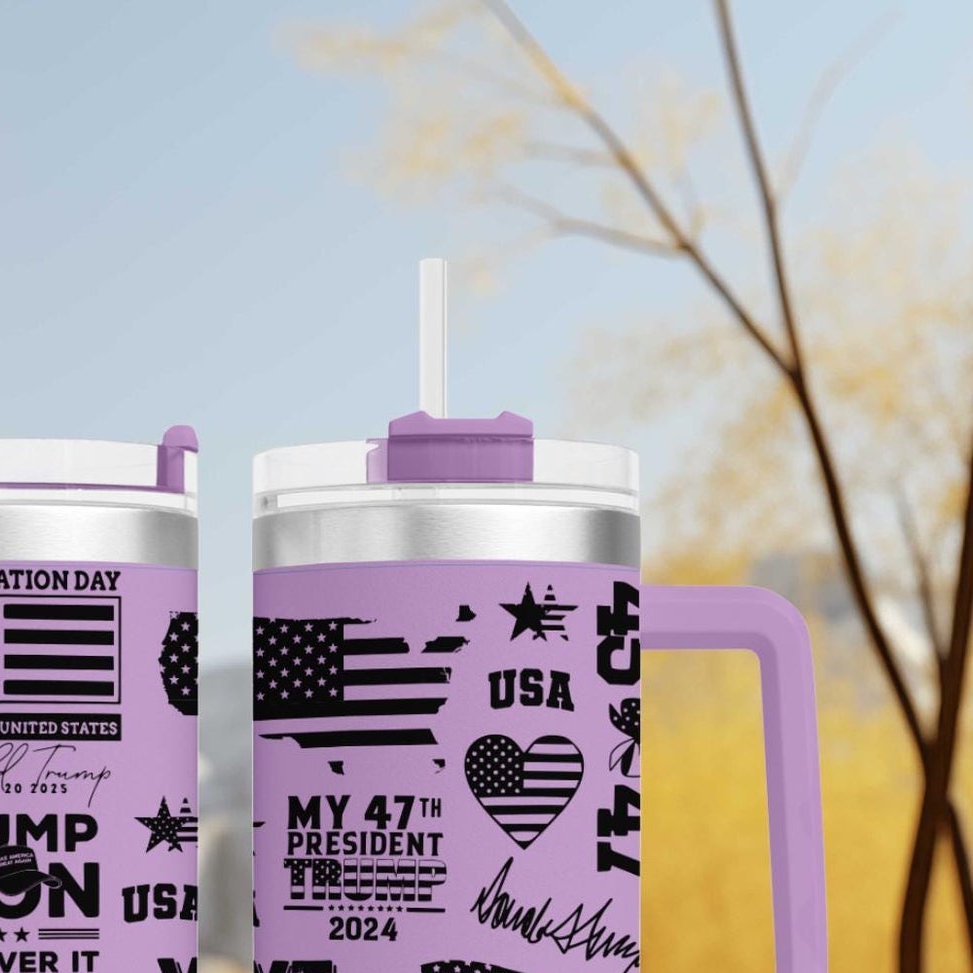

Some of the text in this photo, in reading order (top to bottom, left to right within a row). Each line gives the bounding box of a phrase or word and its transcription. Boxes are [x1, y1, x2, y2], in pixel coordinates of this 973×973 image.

[74, 570, 121, 591] DAY
[488, 668, 575, 712] USA
[0, 721, 58, 734] UNITED
[61, 722, 118, 735] STATES
[32, 743, 111, 808] Trump
[4, 783, 23, 794] 20
[30, 783, 68, 794] 2025
[287, 795, 351, 830] MY
[287, 831, 444, 856] PRESIDENT
[283, 858, 447, 902] TRUMP
[328, 916, 398, 941] 2024
[71, 951, 99, 972] IT
